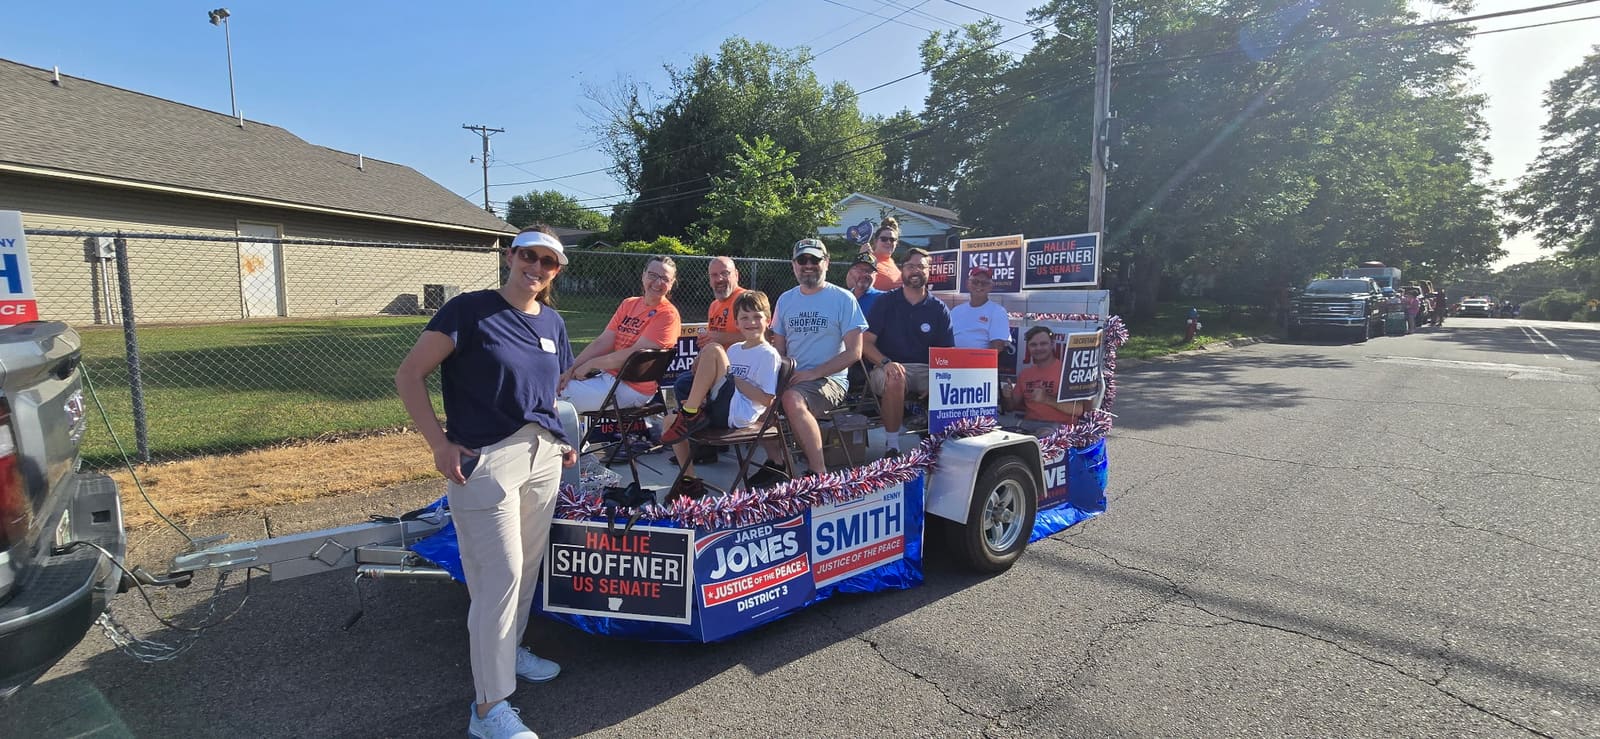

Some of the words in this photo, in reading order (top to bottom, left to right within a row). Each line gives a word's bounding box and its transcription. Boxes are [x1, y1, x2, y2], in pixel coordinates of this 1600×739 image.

[1044, 240, 1076, 252] HALLIE
[969, 251, 1015, 268] KELLY
[1029, 250, 1091, 266] SHOFFNER
[929, 264, 954, 275] FFNER
[1036, 266, 1048, 275] US
[1049, 264, 1081, 275] SENATE
[935, 357, 949, 366] Vote
[939, 382, 991, 405] Varnell
[937, 409, 961, 419] Justice
[962, 408, 969, 417] of
[969, 408, 979, 416] the
[980, 408, 995, 416] Peace
[601, 424, 614, 433] US
[1044, 465, 1066, 488] VE
[883, 492, 901, 501] KENNY
[735, 525, 773, 543] JARED
[816, 502, 900, 556] SMITH
[586, 532, 651, 553] HALLIE
[710, 531, 799, 579] JONES
[817, 556, 850, 574] JUSTICE
[852, 552, 862, 562] OF
[864, 548, 877, 559] THE
[878, 540, 900, 554] PEACE
[556, 549, 679, 581] SHOFFNER
[573, 576, 594, 592] US
[599, 578, 661, 598] SENATE
[714, 576, 754, 599] JUSTICE
[763, 573, 775, 582] THE
[775, 561, 801, 579] PEACE
[737, 588, 780, 612] DISTRICT
[782, 585, 788, 595] 3
